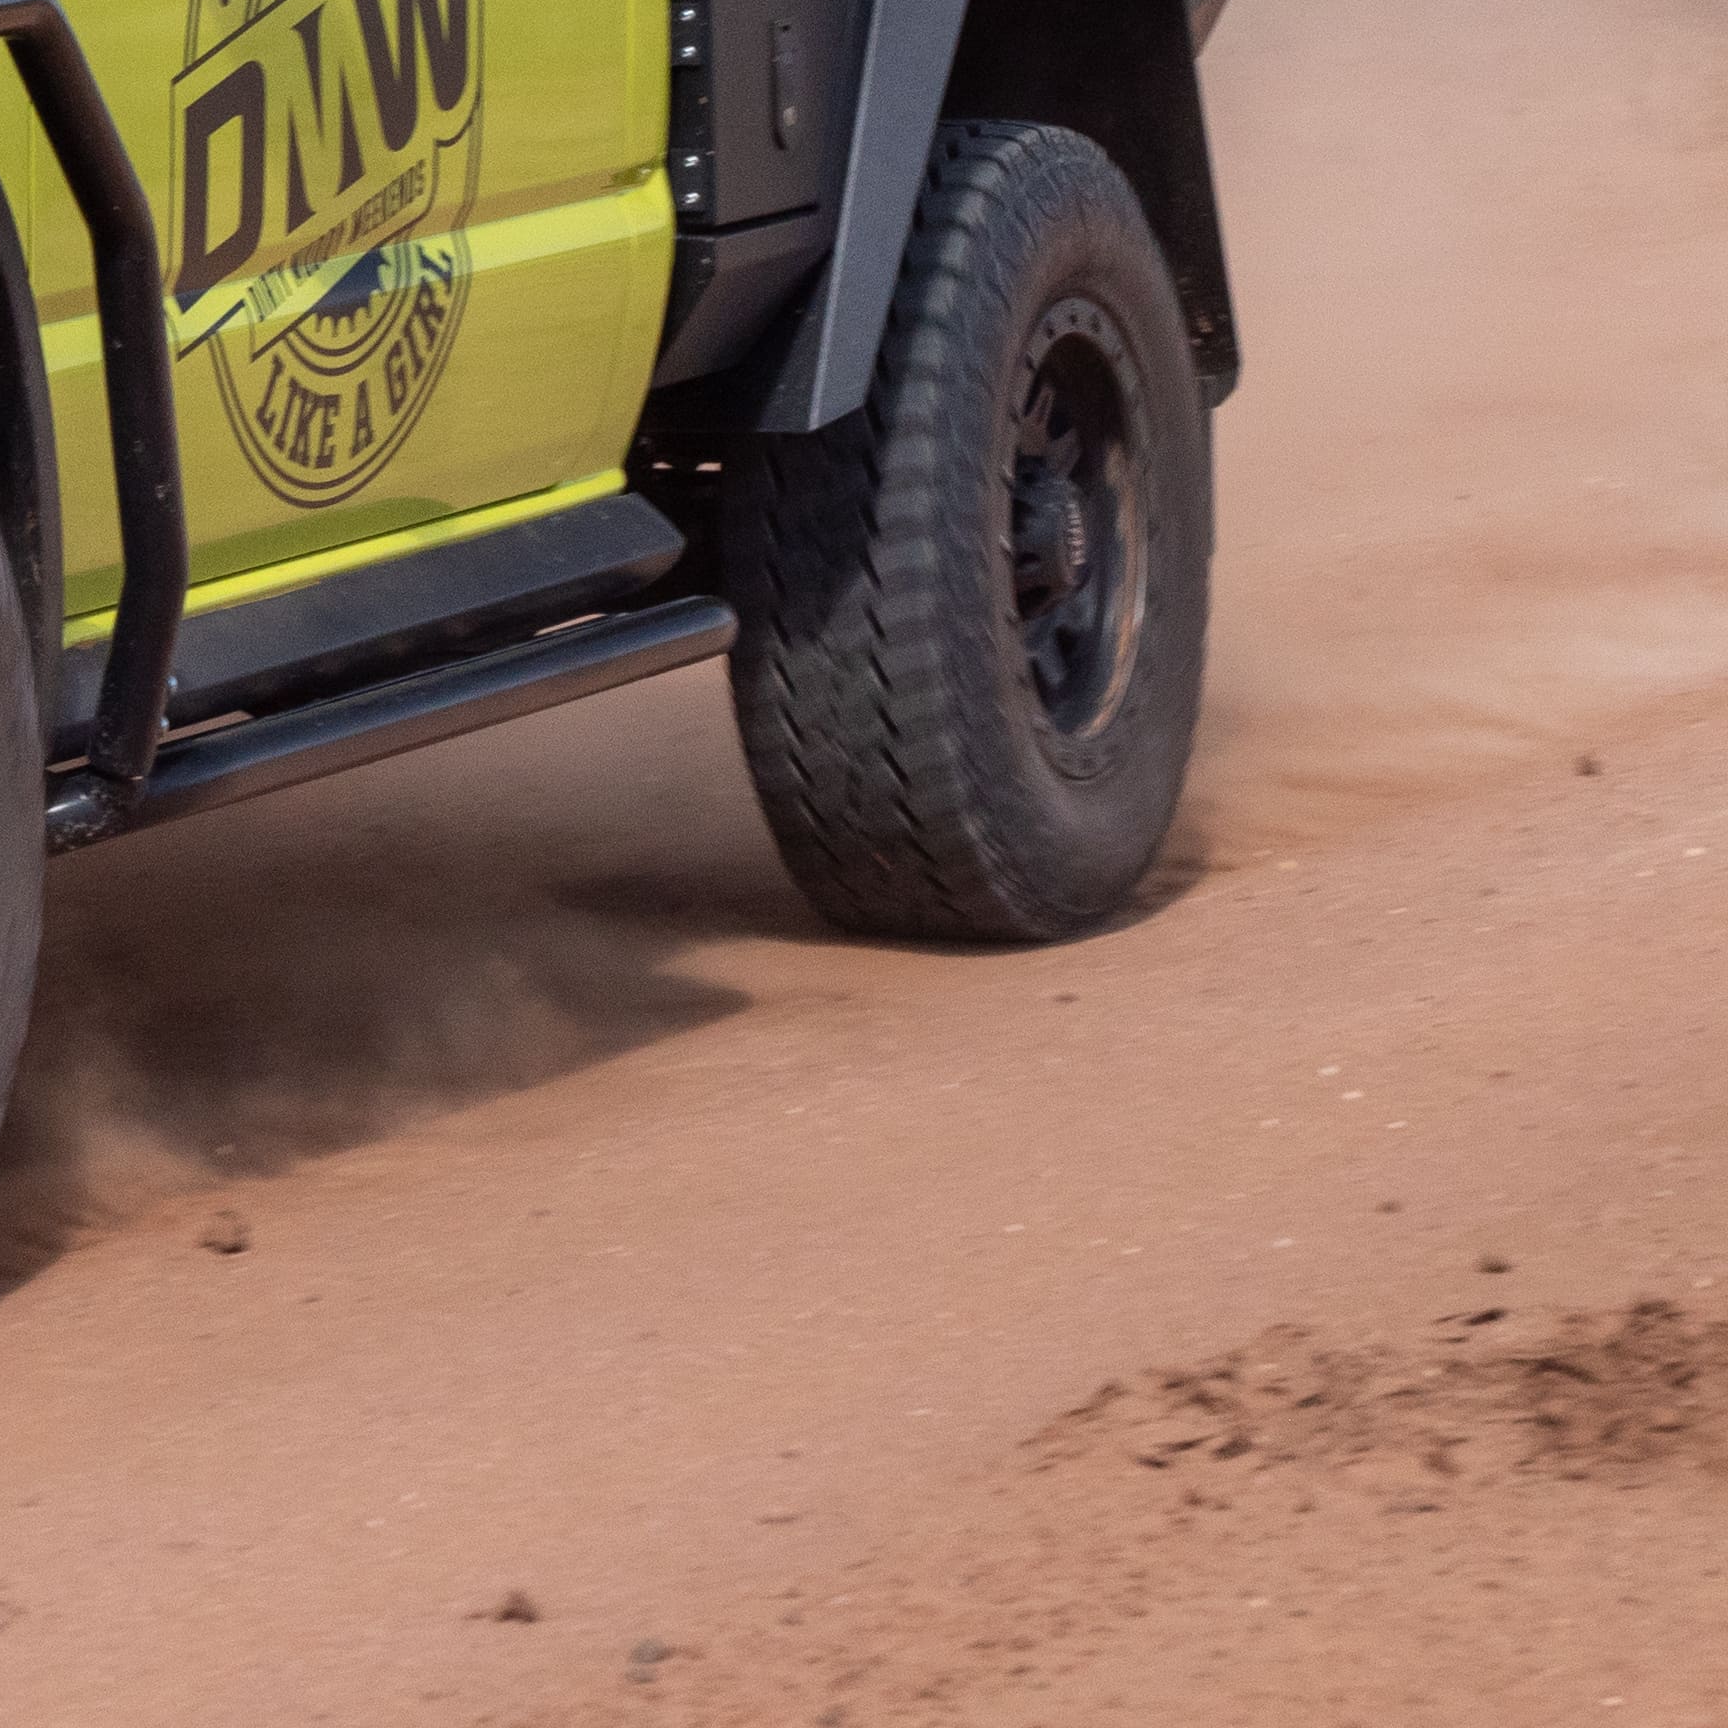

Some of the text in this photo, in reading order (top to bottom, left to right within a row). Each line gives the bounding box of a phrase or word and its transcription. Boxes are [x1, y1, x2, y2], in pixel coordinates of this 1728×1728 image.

[256, 242, 454, 469] LIKE A GIRL
